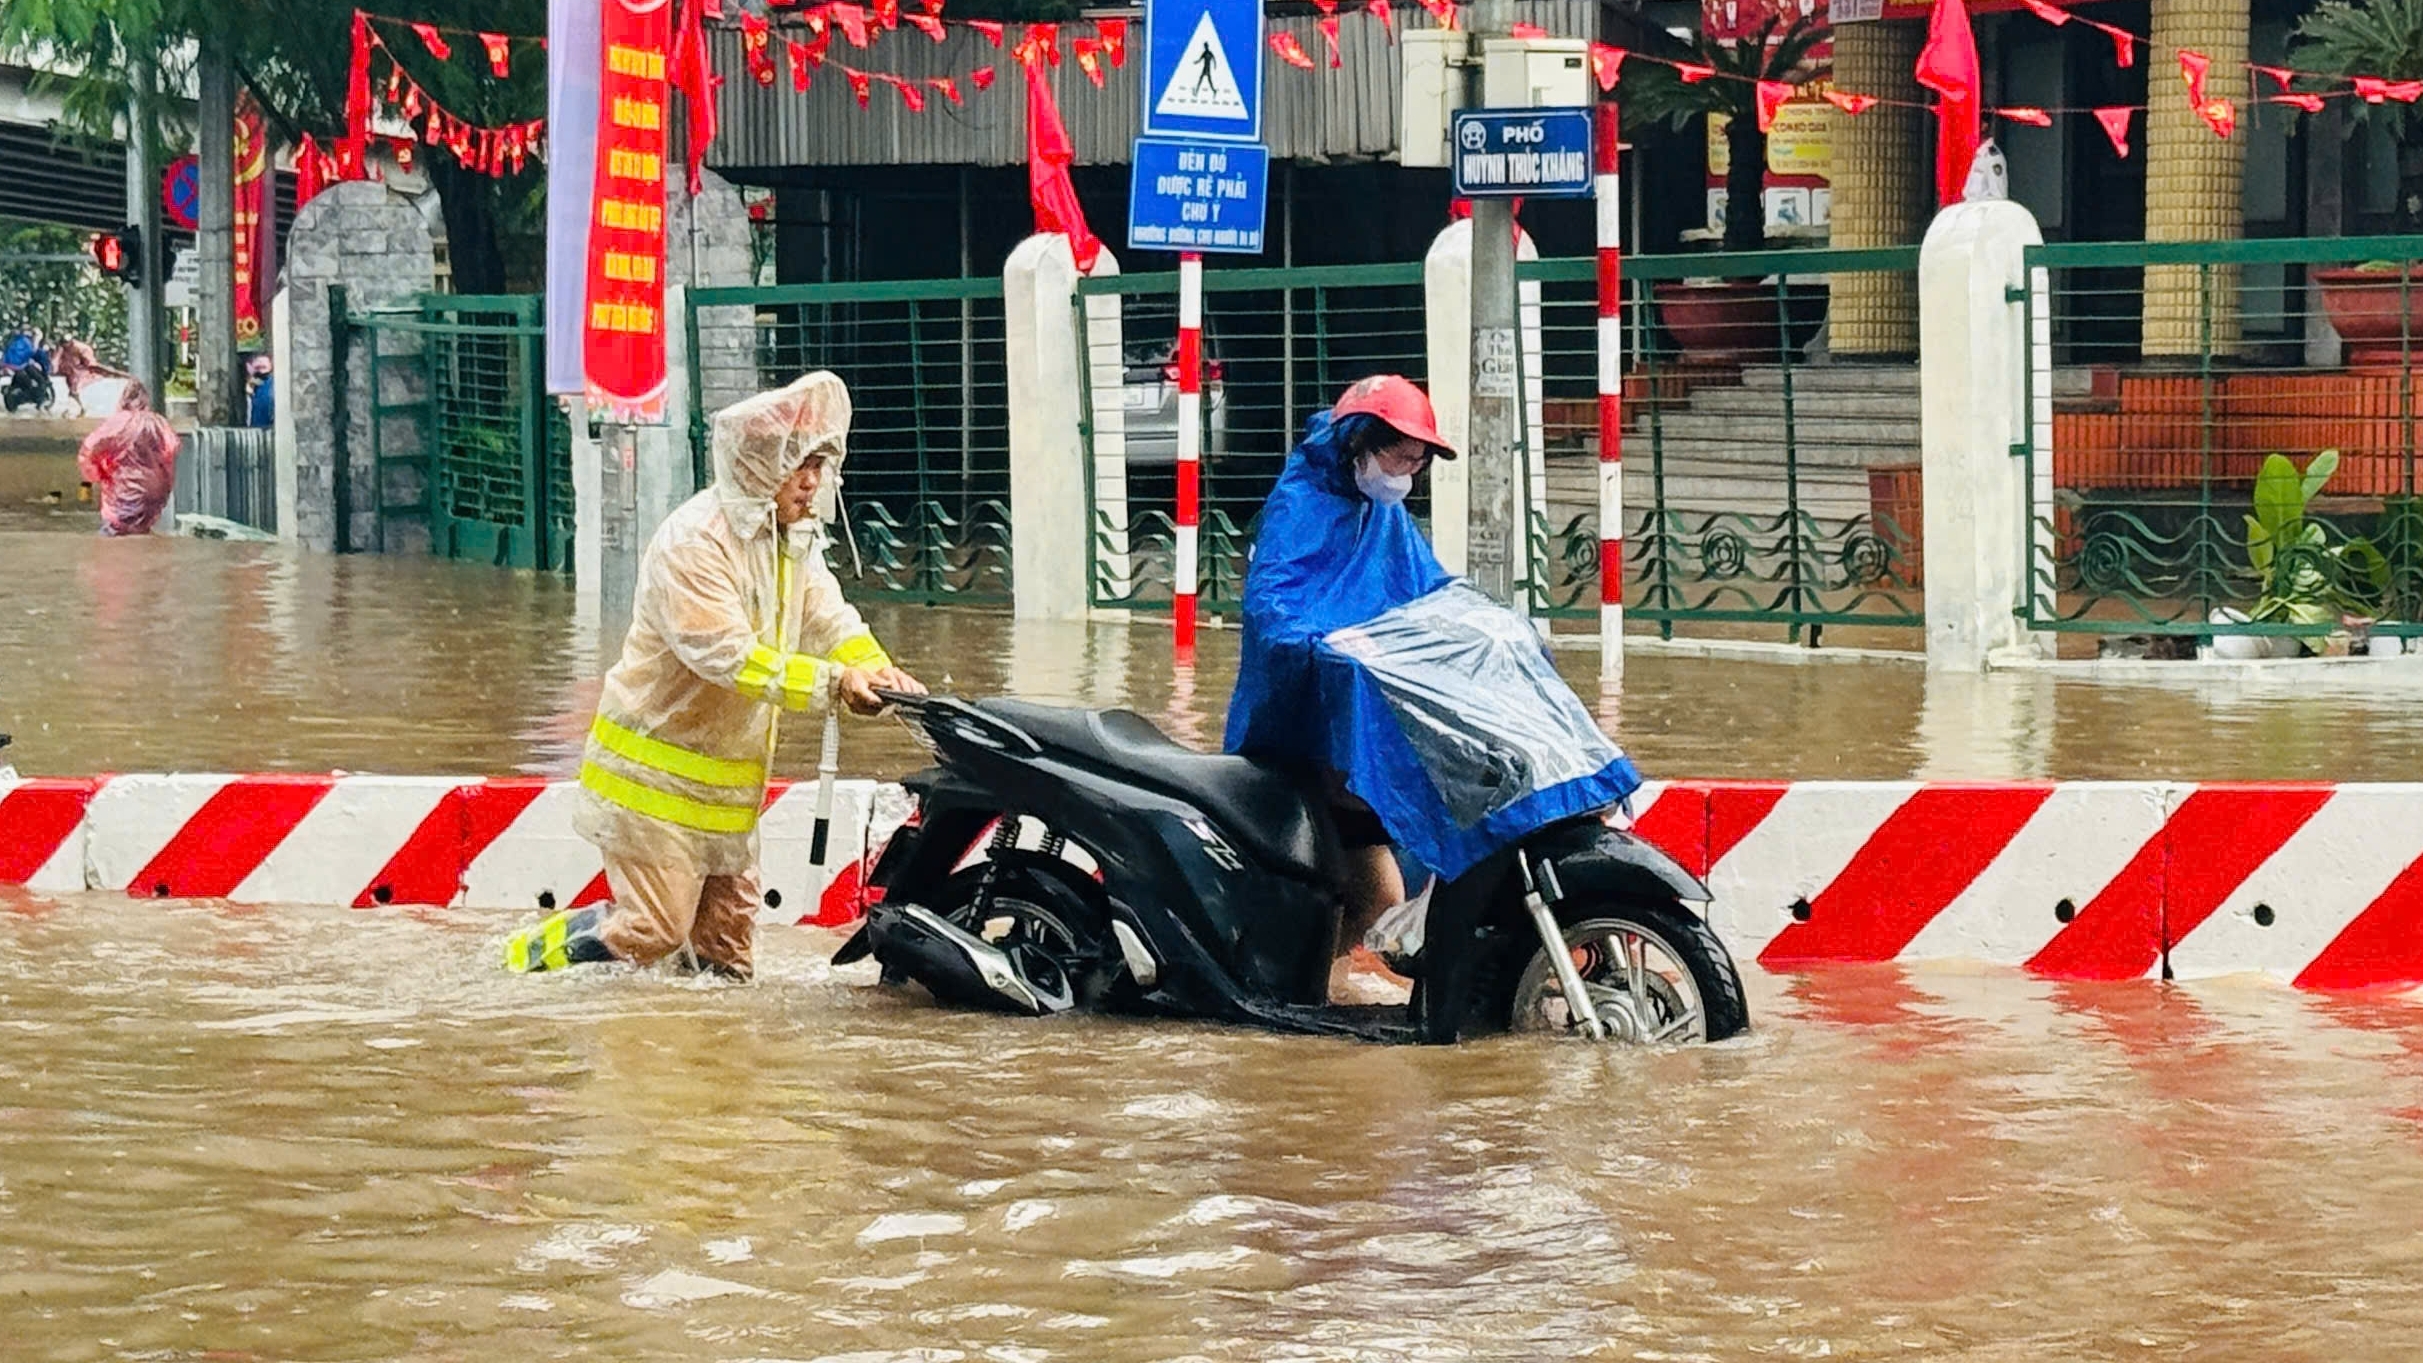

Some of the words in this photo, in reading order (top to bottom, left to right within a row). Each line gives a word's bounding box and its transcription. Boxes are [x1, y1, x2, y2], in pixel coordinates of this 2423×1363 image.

[1502, 119, 1545, 143] PHỐ
[1463, 148, 1506, 184] HUỲNH
[1507, 146, 1541, 184] THÚC
[1541, 145, 1585, 183] KHÁNG
[1217, 172, 1247, 199] PHẢI
[1182, 198, 1208, 222] CHÚ
[1212, 198, 1221, 222] Ý
